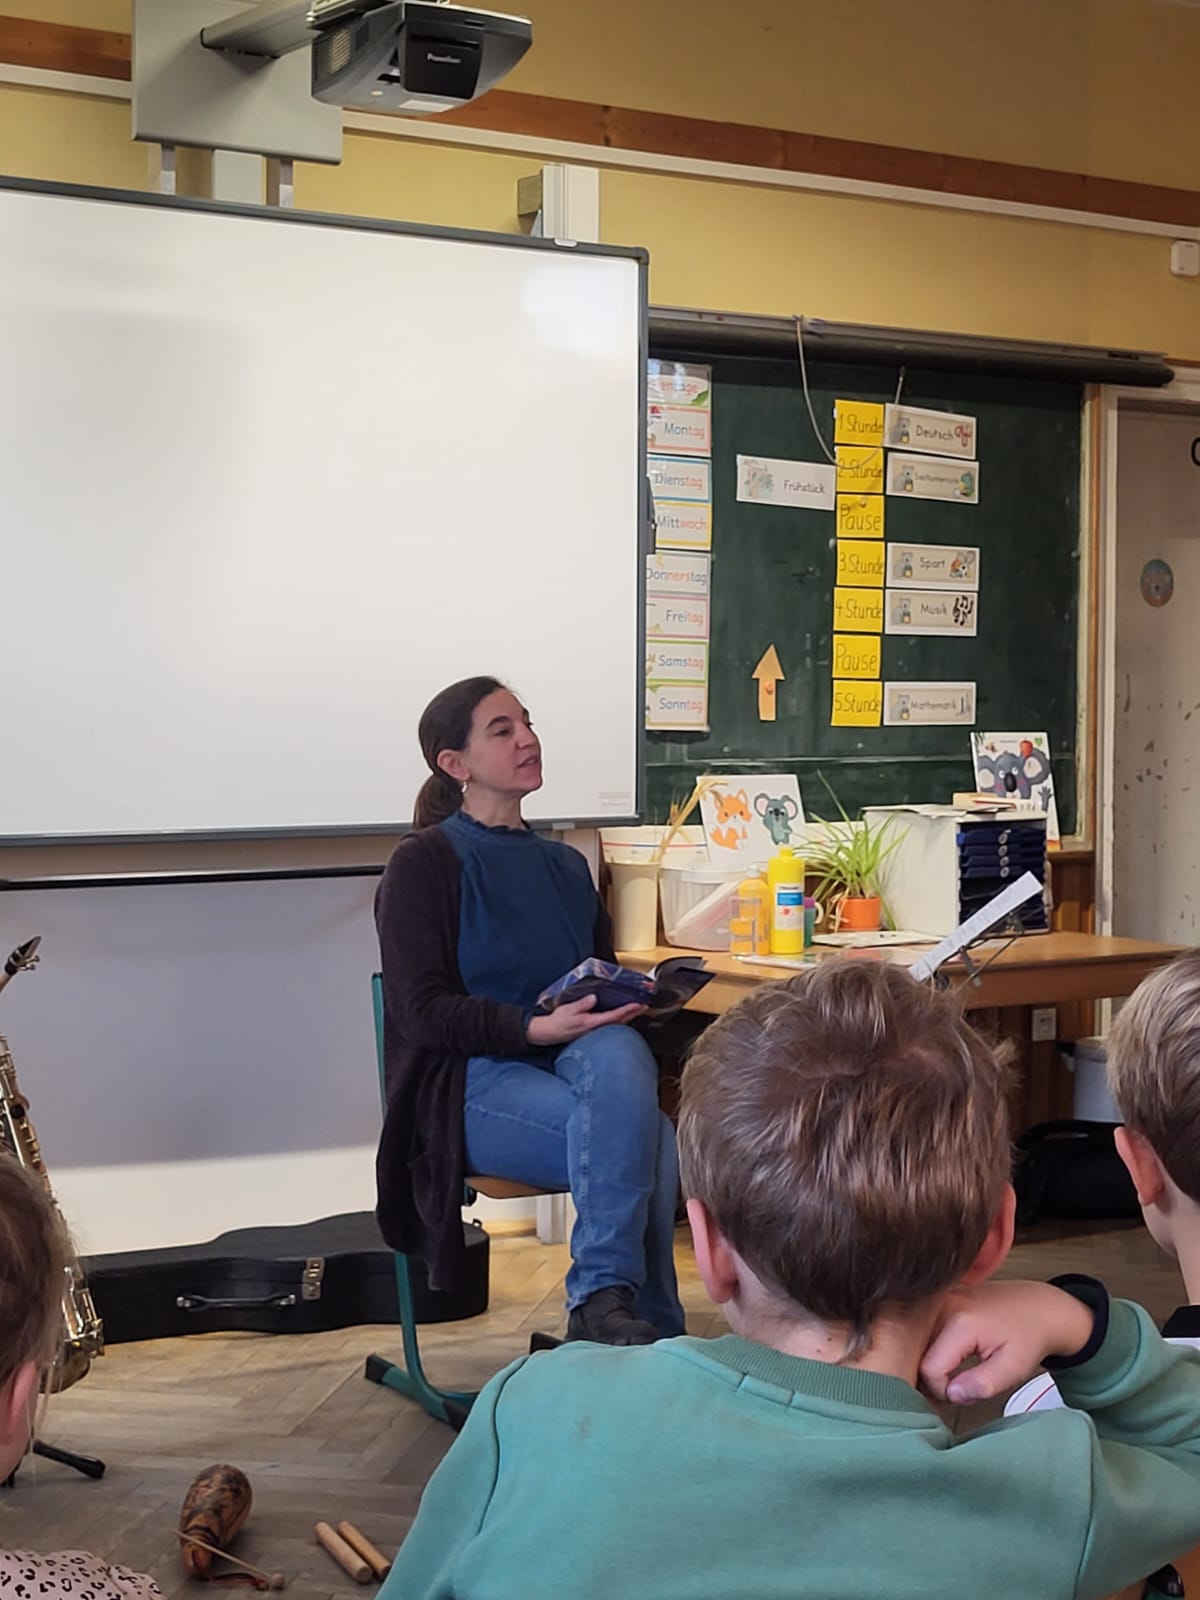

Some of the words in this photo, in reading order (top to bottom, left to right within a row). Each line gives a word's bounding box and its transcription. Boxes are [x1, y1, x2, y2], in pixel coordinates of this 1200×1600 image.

[663, 422, 705, 440] Montag
[846, 414, 884, 434] Stunde
[915, 424, 954, 441] Deutsch
[654, 472, 704, 488] Dienstag
[656, 515, 707, 530] Mittwoch
[839, 503, 881, 531] Pause
[839, 552, 847, 572] 3
[919, 556, 946, 572] Sport
[645, 567, 707, 586] Donnerstag
[665, 609, 704, 625] Freitag
[920, 602, 948, 615] Musik
[658, 656, 704, 672] Samstag
[834, 642, 878, 671] Pause
[659, 697, 703, 714] Sonntag
